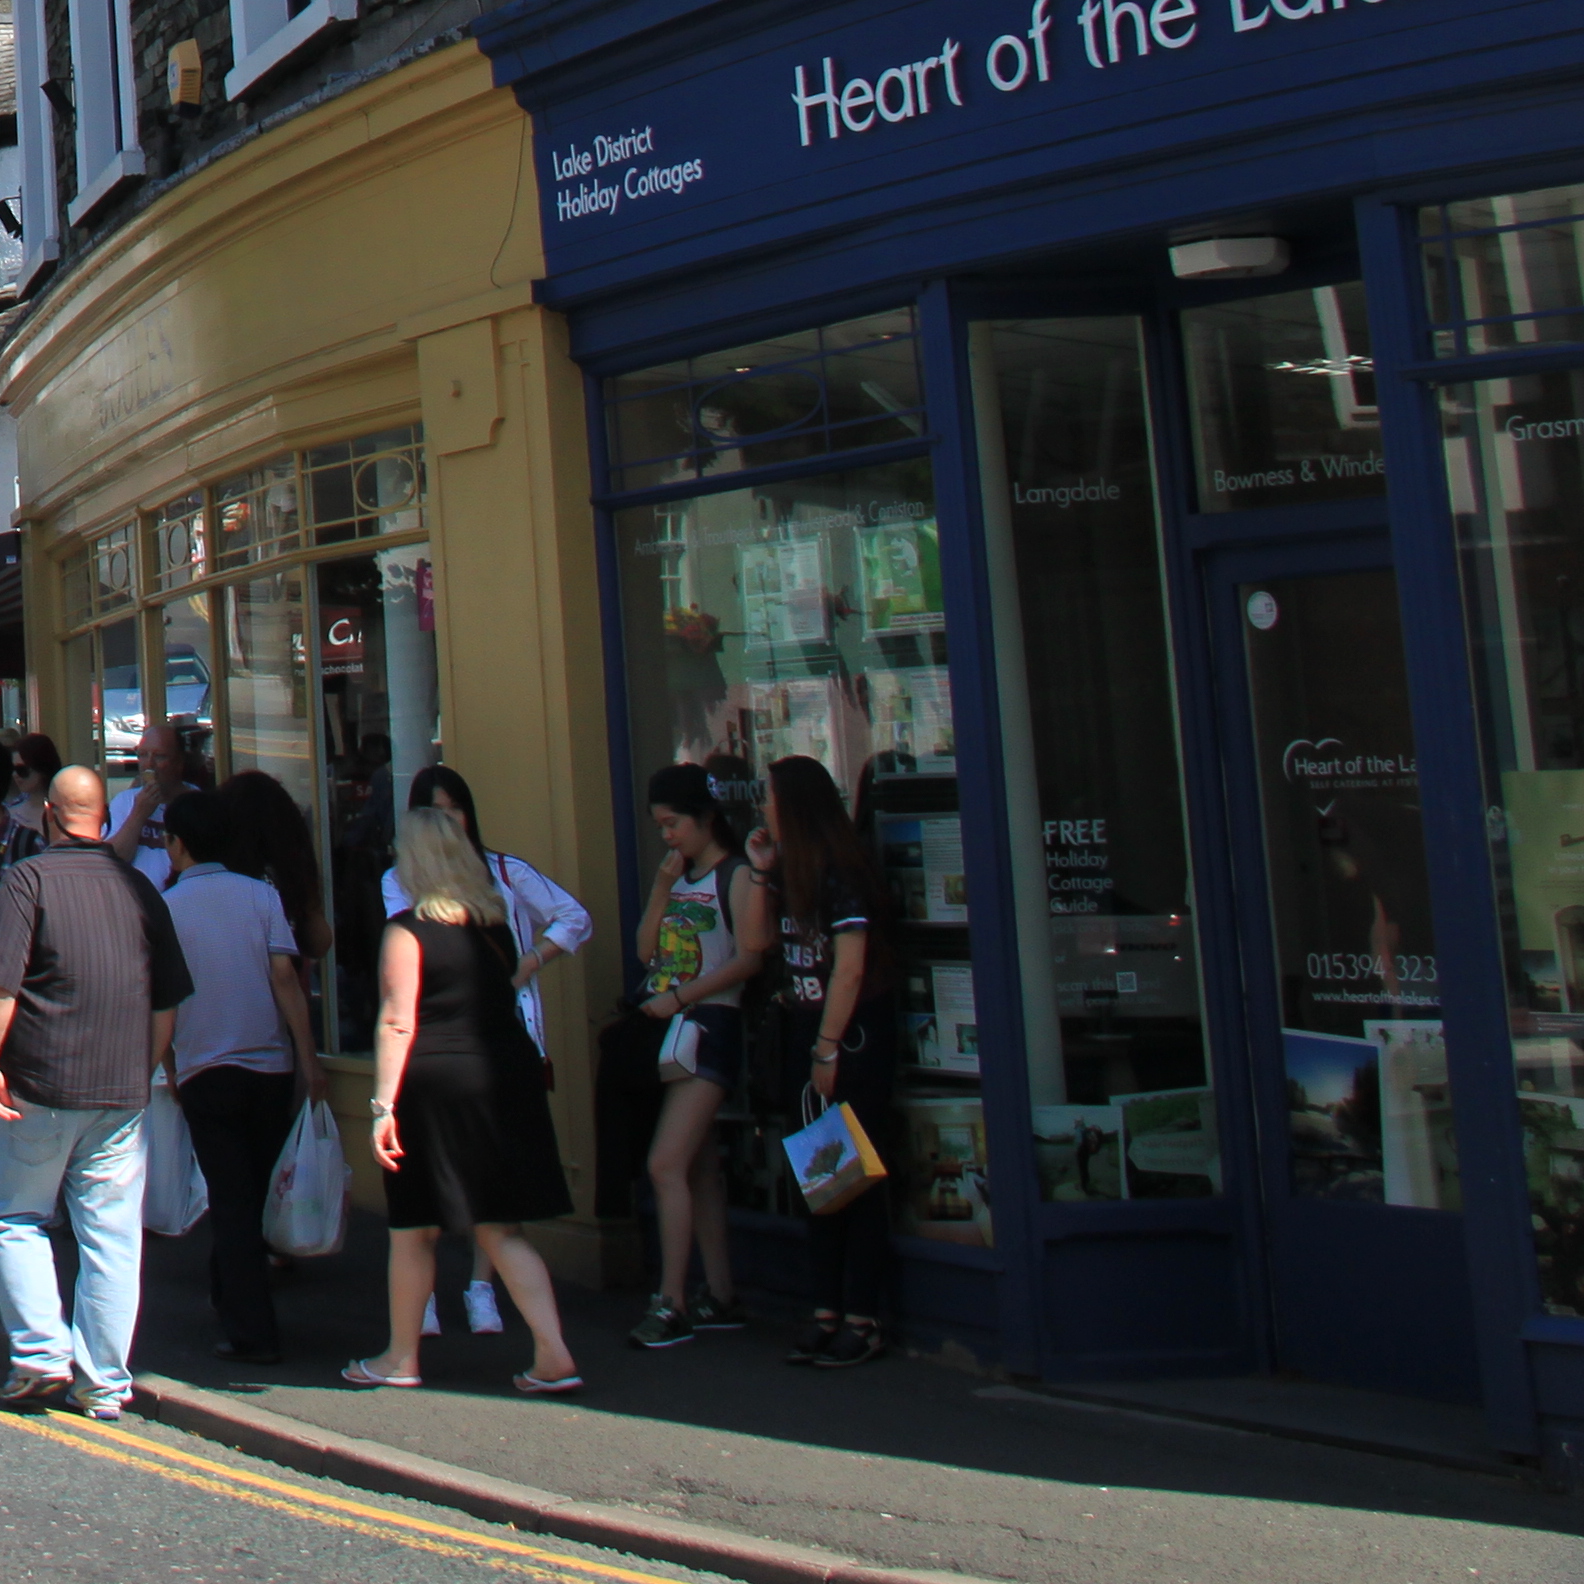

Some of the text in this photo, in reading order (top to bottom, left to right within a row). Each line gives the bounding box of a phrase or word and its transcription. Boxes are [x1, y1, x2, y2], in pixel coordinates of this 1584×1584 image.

[792, 36, 963, 147] Heart
[552, 125, 654, 181] Lake District
[557, 158, 703, 222] Holiday Cottages
[1214, 467, 1295, 493] Bowness
[1301, 461, 1317, 483] &
[1014, 477, 1120, 508] Langdale
[869, 499, 925, 522] Coniston
[1294, 757, 1341, 776] Heart
[1345, 755, 1362, 775] of
[1366, 755, 1395, 774] the
[1333, 778, 1378, 789] CATERING
[1382, 778, 1394, 787] AT
[1042, 818, 1108, 847] FREE
[1045, 849, 1109, 870] Holiday
[1047, 873, 1114, 894] Cottage
[1049, 895, 1099, 915] Guide
[1306, 952, 1439, 982] 015394 323
